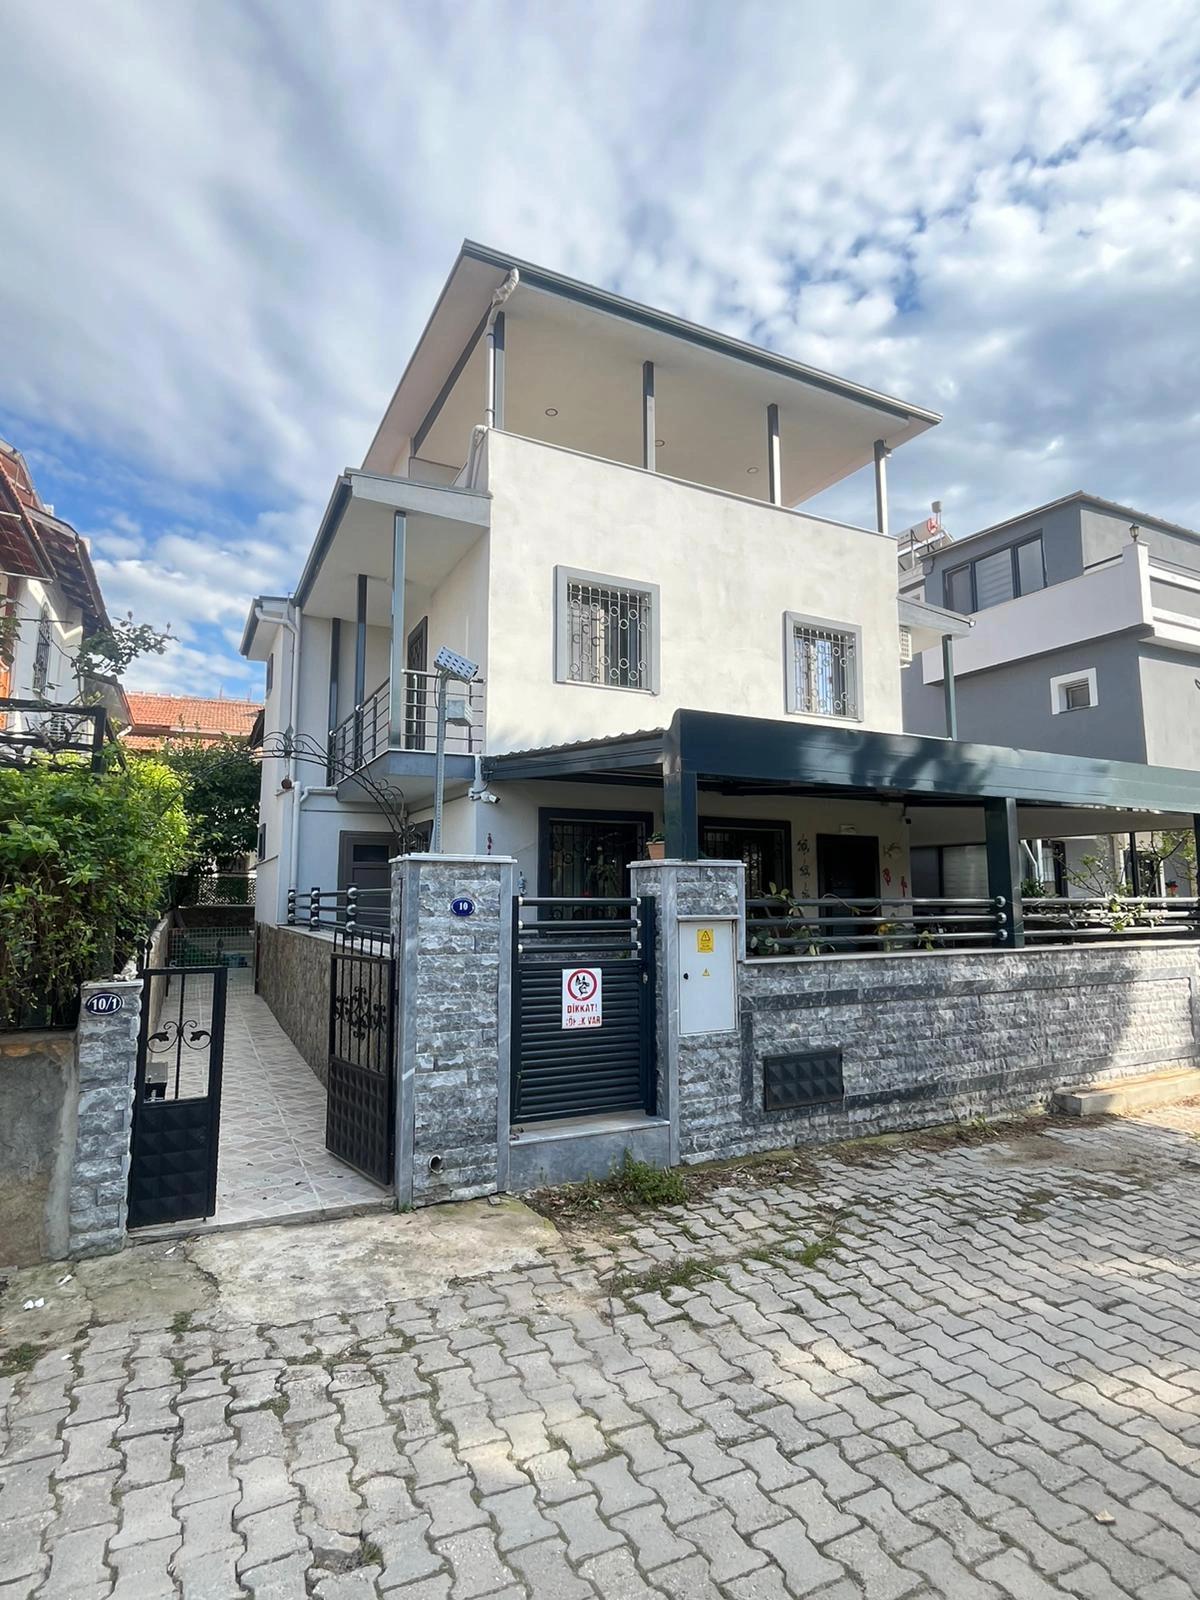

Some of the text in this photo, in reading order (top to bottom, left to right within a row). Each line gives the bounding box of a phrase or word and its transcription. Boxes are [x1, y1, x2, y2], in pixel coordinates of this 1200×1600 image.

[459, 902, 468, 910] 10
[92, 996, 117, 1010] 10/1
[567, 1003, 597, 1013] DİKKAT!
[587, 1015, 601, 1025] VAR
